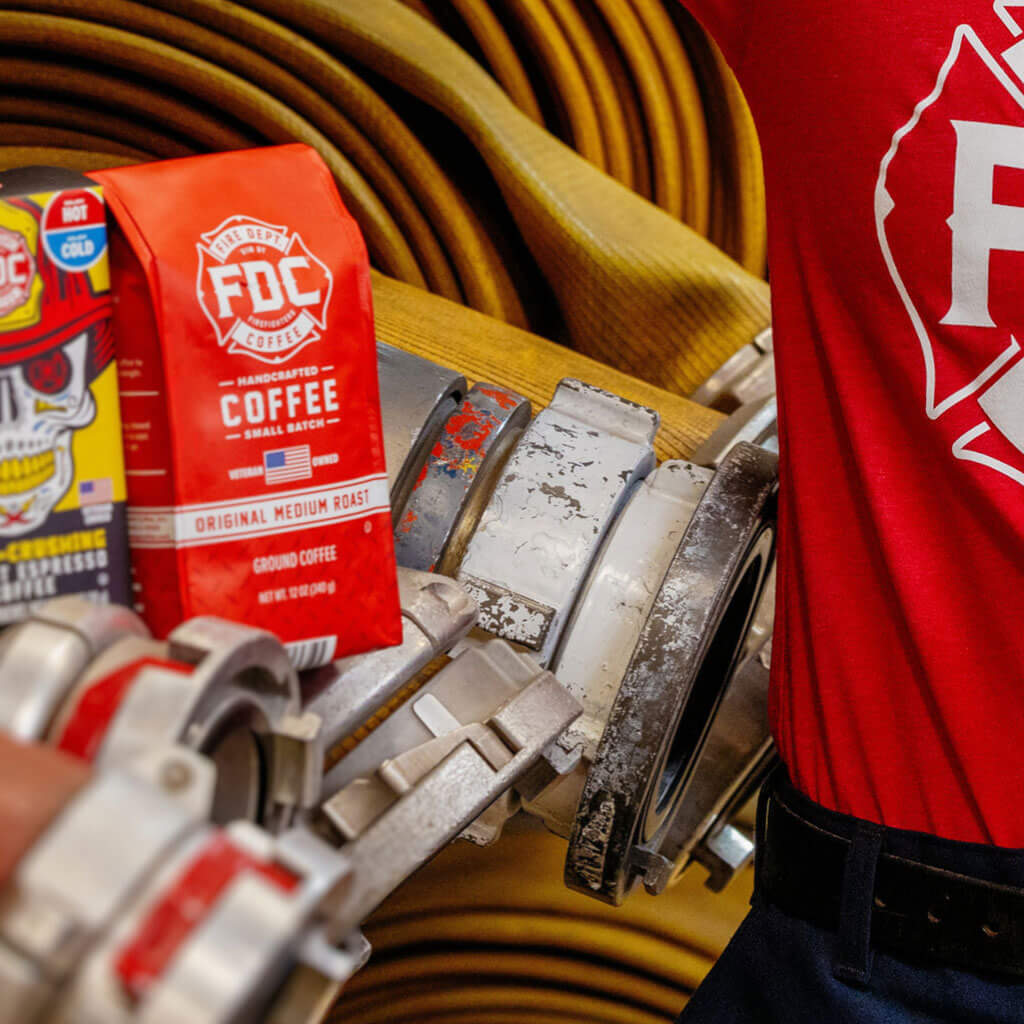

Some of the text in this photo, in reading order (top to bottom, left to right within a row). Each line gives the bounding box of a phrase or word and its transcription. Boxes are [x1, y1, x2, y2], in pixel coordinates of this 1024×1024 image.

[62, 204, 88, 223] HOT
[61, 240, 95, 259] COLD
[216, 228, 242, 254] FIRE
[206, 255, 321, 319] FDC
[246, 326, 302, 348] COFFEE
[237, 365, 319, 387] HANDCRAFTED
[220, 378, 339, 427] COFFEE
[244, 419, 325, 440] SMALL BATCH
[195, 509, 267, 533] ORIGINAL
[274, 498, 328, 521] MEDIUM
[333, 488, 369, 512] ROAST
[253, 544, 337, 574] GROUND COFFEE
